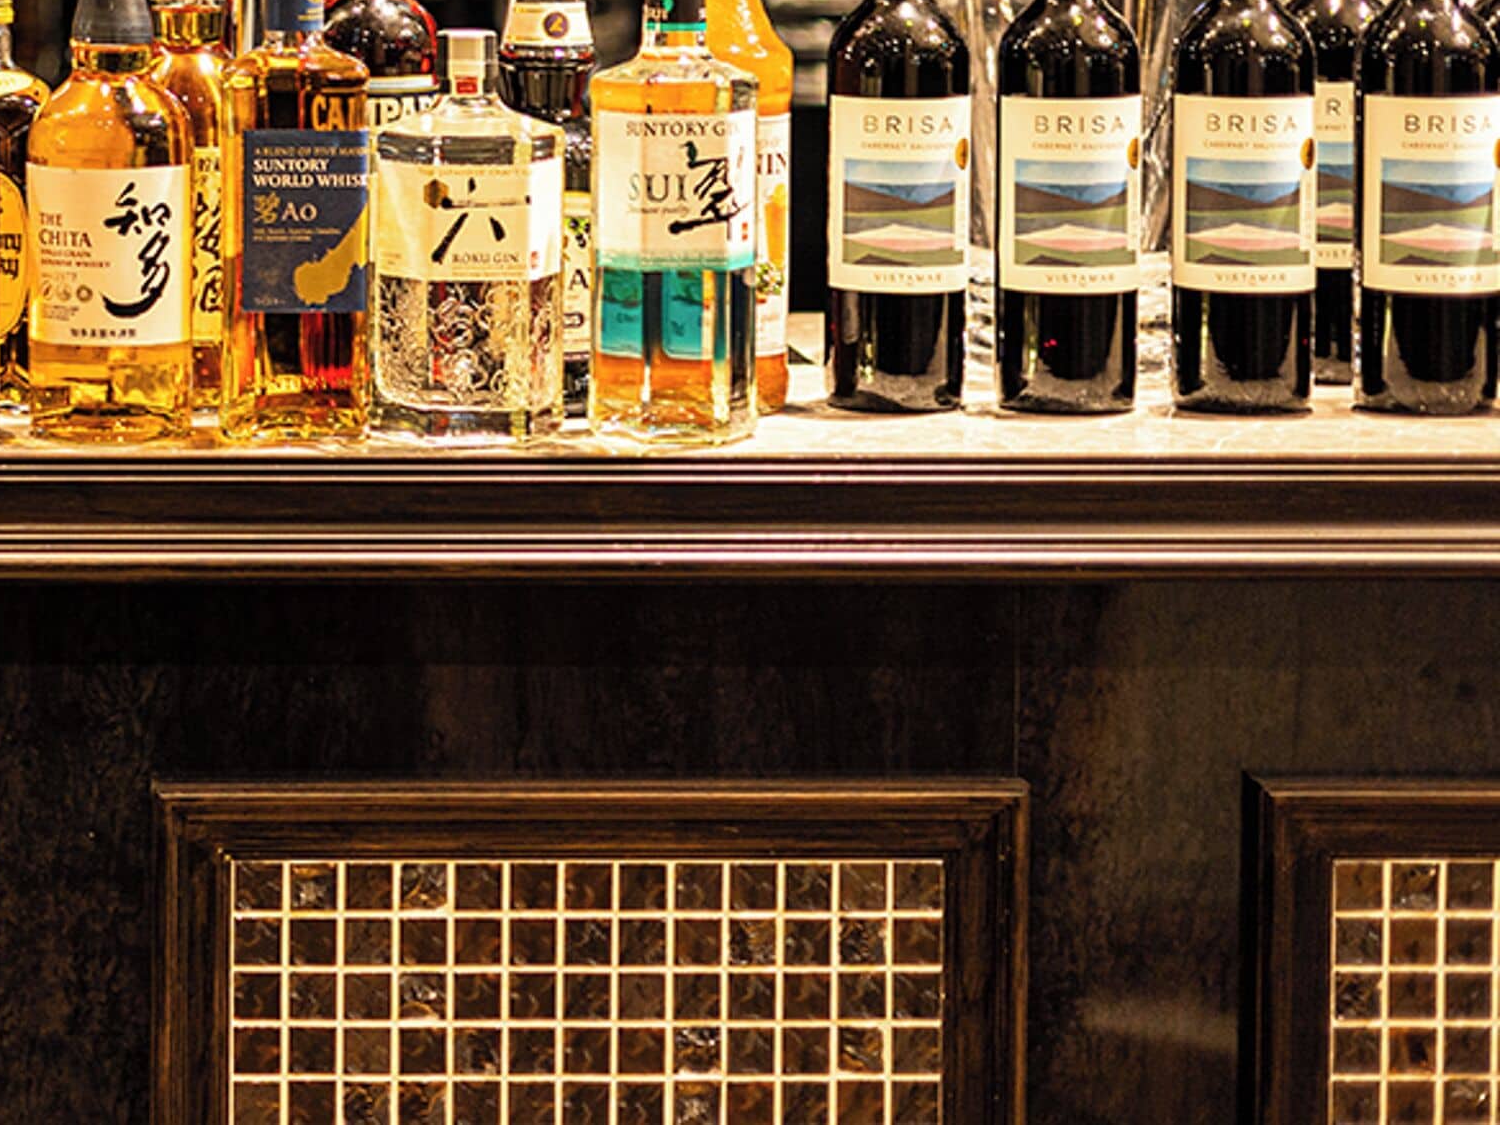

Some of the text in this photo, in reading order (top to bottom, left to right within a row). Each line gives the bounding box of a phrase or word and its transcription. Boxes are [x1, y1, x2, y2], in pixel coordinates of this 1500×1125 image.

[862, 115, 954, 134] BRISA
[1034, 115, 1126, 134] BRISA
[1206, 113, 1298, 134] BRISA
[1404, 114, 1492, 134] BRISA
[252, 158, 330, 173] SUNTORY
[252, 174, 314, 188] WORLD
[628, 173, 687, 203] SUI
[40, 212, 62, 226] THE
[281, 202, 318, 222] AO
[38, 228, 92, 248] CHITA
